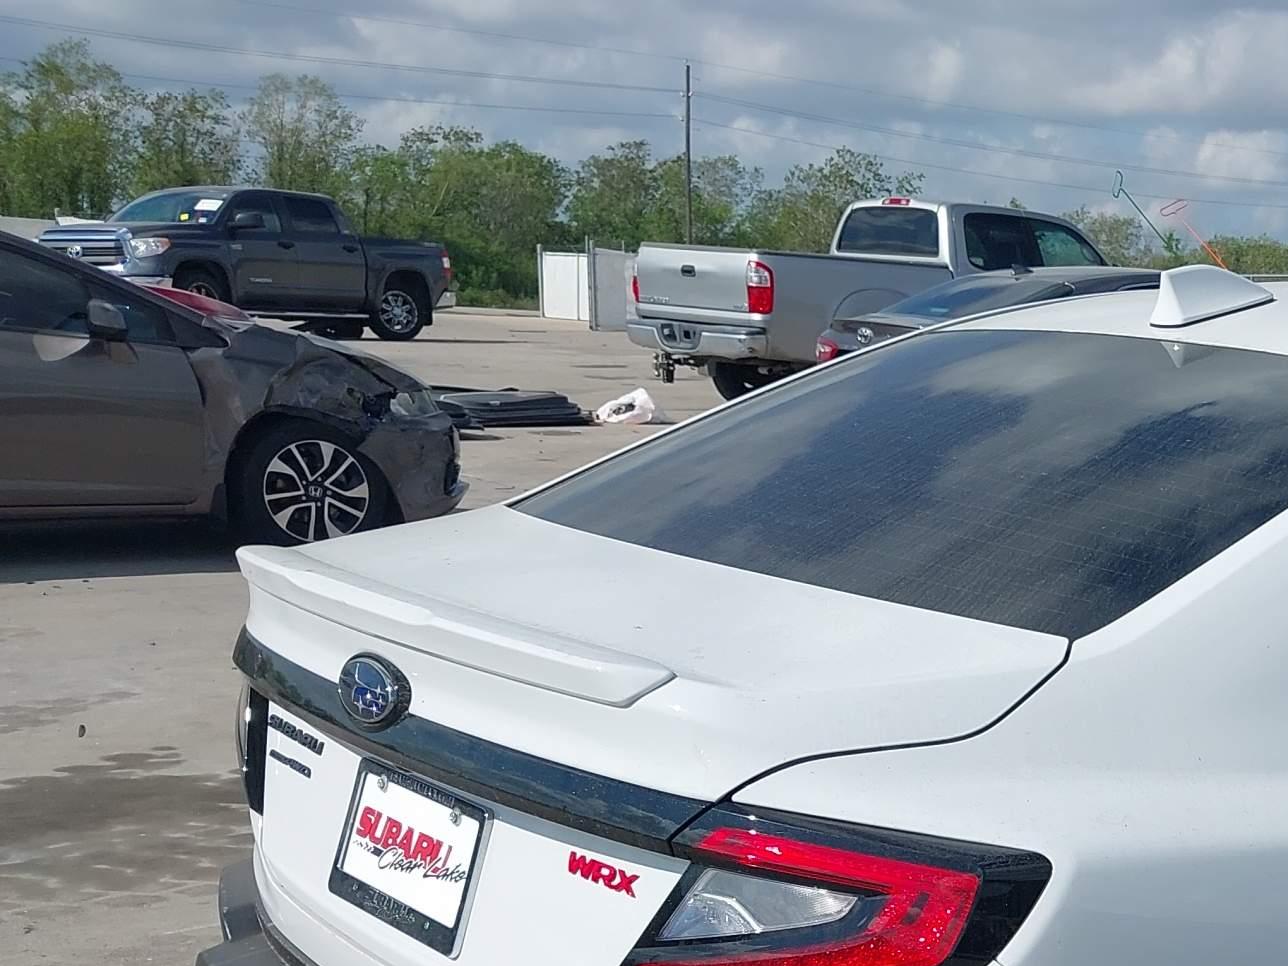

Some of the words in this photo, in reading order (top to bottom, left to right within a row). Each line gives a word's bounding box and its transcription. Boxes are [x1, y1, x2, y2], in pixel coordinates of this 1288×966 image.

[268, 714, 325, 756] SUBARU
[356, 805, 453, 874] SUBARU
[378, 846, 426, 874] Clear
[568, 851, 640, 898] WRX
